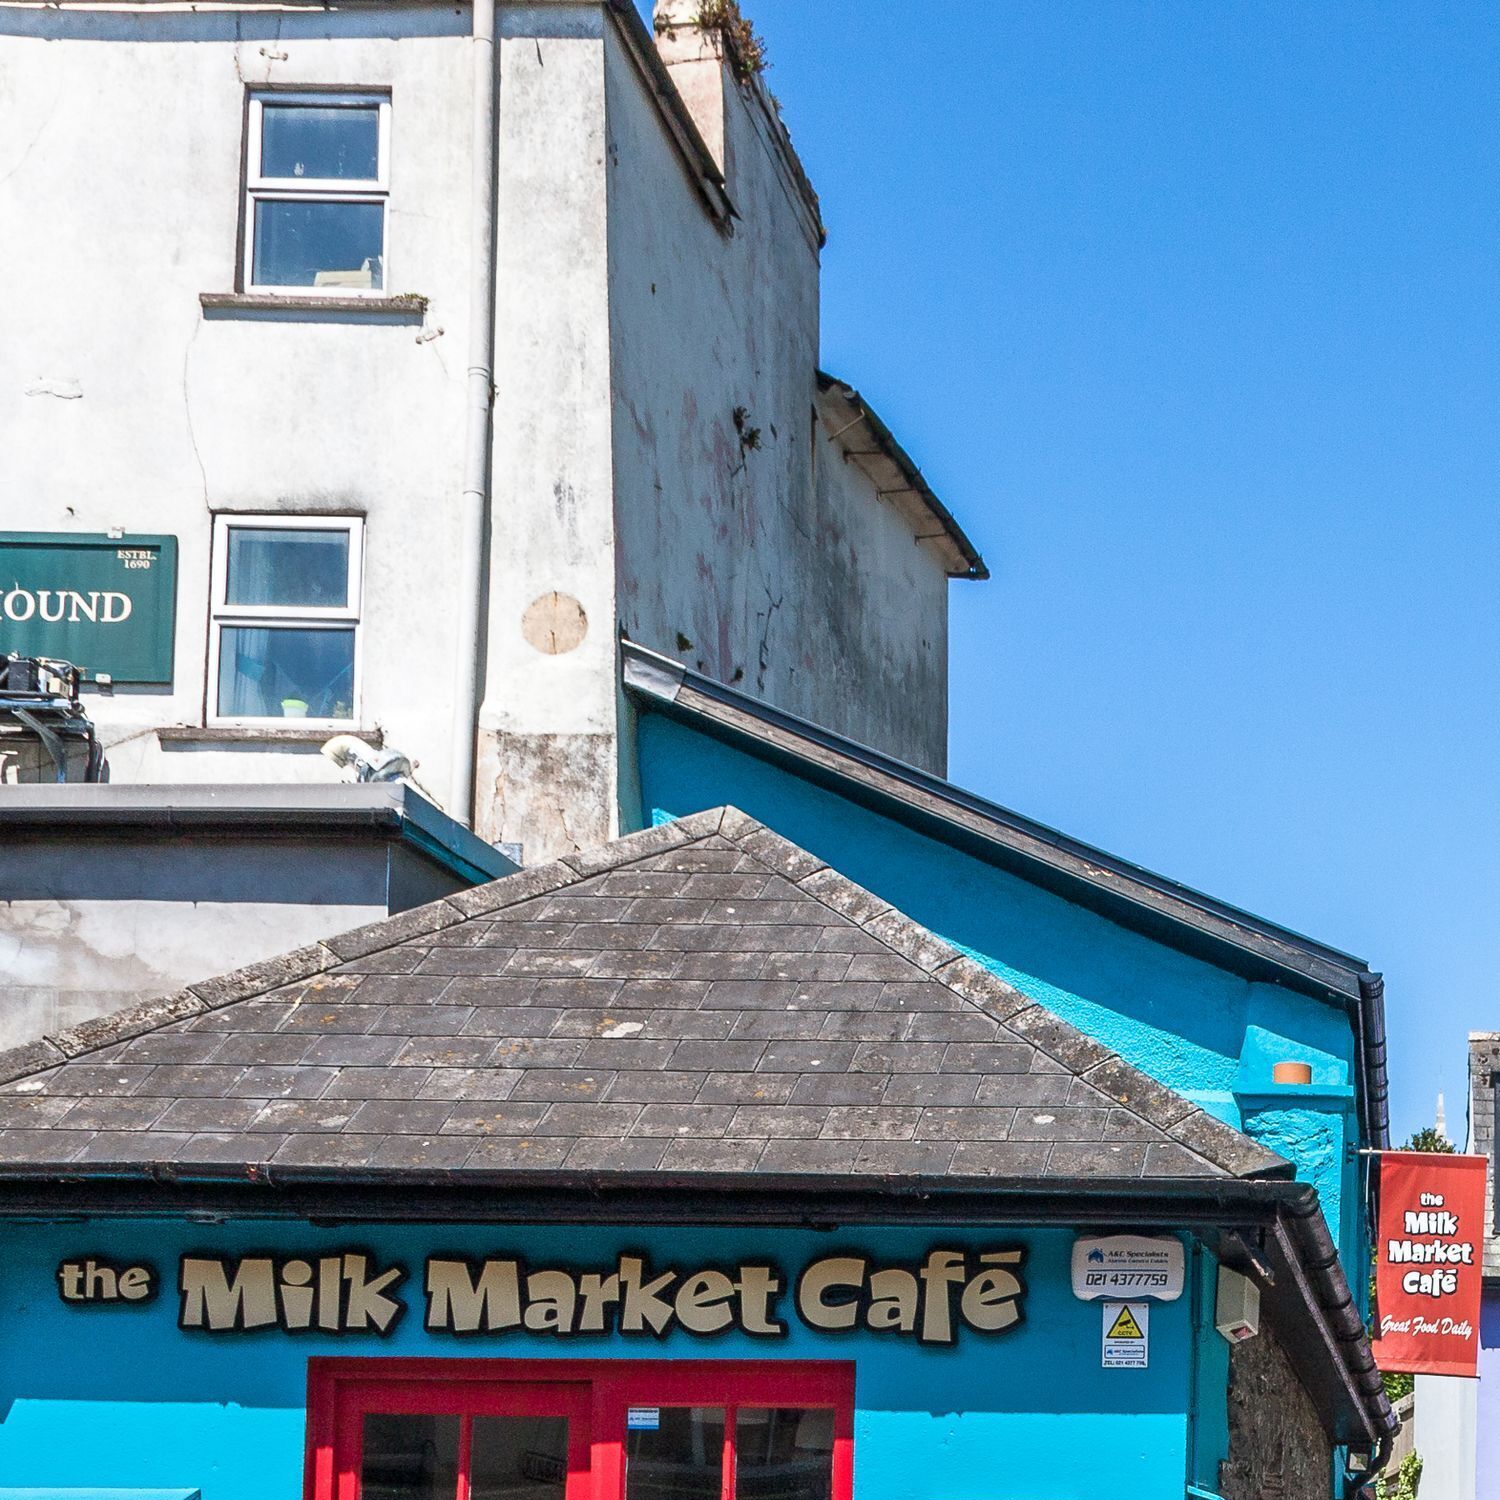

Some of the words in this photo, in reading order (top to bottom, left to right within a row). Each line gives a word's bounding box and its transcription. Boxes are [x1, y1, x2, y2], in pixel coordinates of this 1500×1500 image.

[124, 559, 150, 569] 1690
[1419, 1192, 1444, 1207] the
[1404, 1210, 1459, 1237] Milk
[1388, 1239, 1474, 1265] Market
[1086, 1273, 1107, 1286] 021
[1110, 1273, 1168, 1286] 4377759
[1402, 1269, 1458, 1297] Café
[57, 1259, 154, 1301] the
[180, 1251, 403, 1333] Milk
[425, 1254, 783, 1337] Market
[798, 1249, 1025, 1344] Café
[1380, 1314, 1409, 1337] Great
[1412, 1316, 1440, 1338] Food
[1441, 1318, 1474, 1341] Daily
